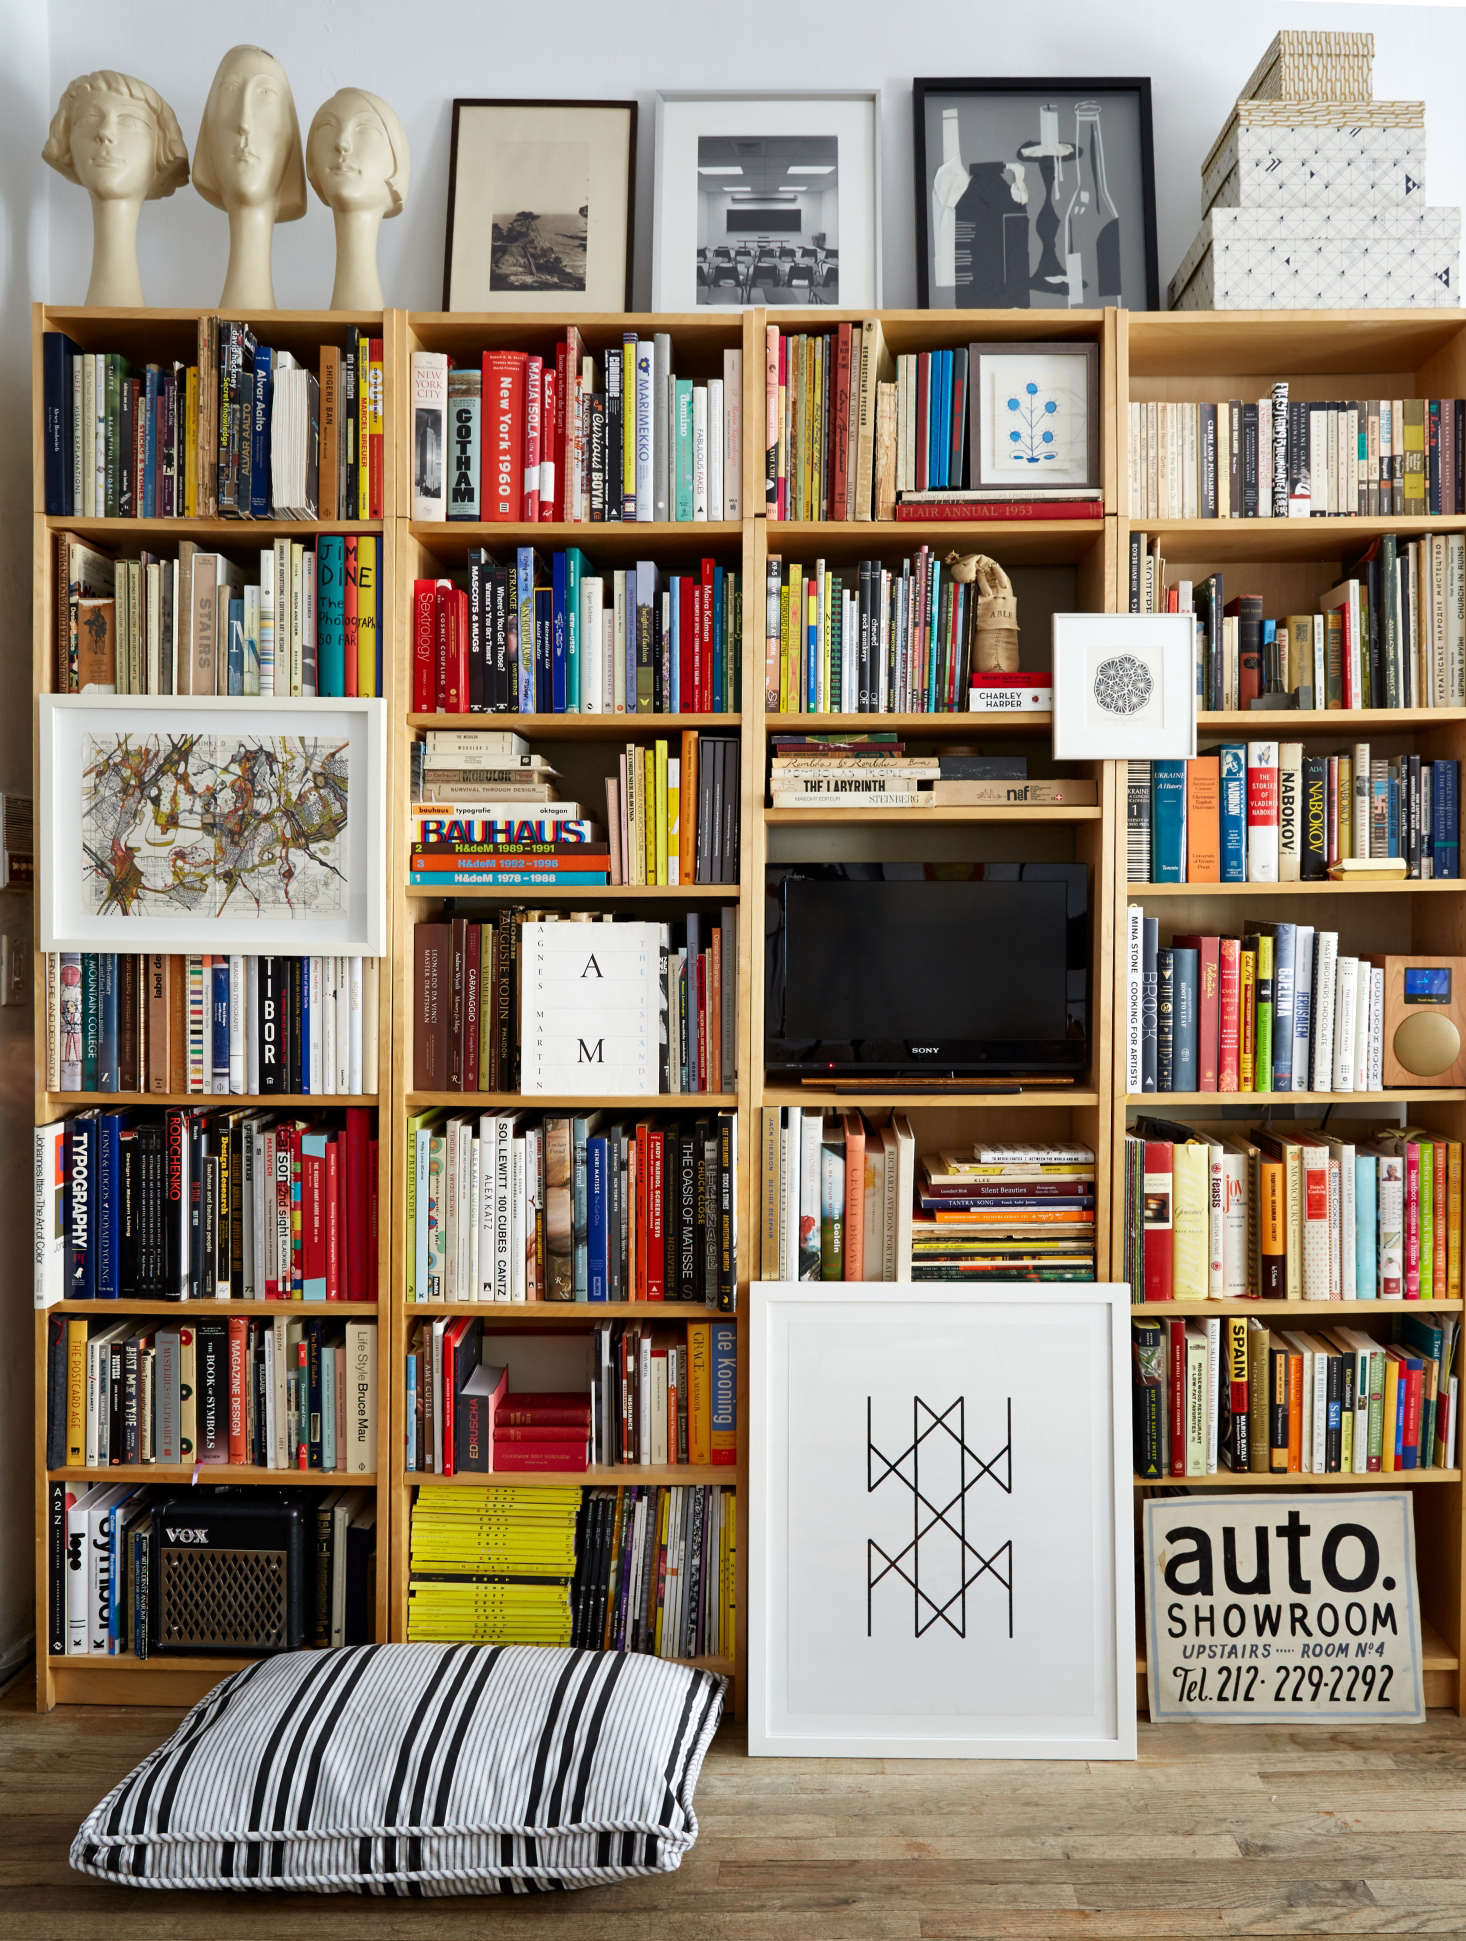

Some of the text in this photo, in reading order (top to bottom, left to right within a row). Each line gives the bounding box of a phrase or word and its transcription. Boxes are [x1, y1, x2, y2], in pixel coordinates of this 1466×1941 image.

[229, 355, 238, 388] hockney
[256, 370, 266, 400] Alvar
[415, 380, 441, 388] YORK
[416, 371, 441, 379] NEW
[416, 390, 441, 398] CITY
[610, 357, 620, 397] commune
[256, 402, 264, 431] Aalto
[528, 362, 538, 438] MAIJA ISOLA
[639, 379, 649, 461] MARIMEKKO
[221, 402, 229, 446] Knowledge
[499, 377, 511, 495] New York 1960
[453, 409, 474, 503] GOTHAM
[592, 414, 604, 508] Curious BOYM
[902, 506, 1032, 517] FLAIR ANNUAL 1953
[320, 542, 358, 560] JIM
[199, 598, 211, 668] STAIRS
[418, 593, 433, 661] Sextrology
[497, 586, 505, 671] Where'd You Get Those?
[703, 585, 711, 642] Maira Kalman
[871, 619, 879, 646] chewed
[804, 780, 824, 792] THE
[1310, 767, 1323, 775] ADA
[869, 795, 919, 803] STEINBERG
[1282, 772, 1295, 850] NABOKOV
[1309, 781, 1323, 853] NABOKOV
[418, 820, 586, 842] BAUHAUS
[455, 844, 494, 853] H&deM
[416, 874, 420, 882] 1
[455, 874, 493, 882] H&deM
[417, 859, 424, 867] 3
[458, 860, 496, 868] H&deM
[1131, 917, 1139, 940] MINA
[499, 916, 510, 1019] AUGUSTE RODIN
[581, 954, 603, 978] A
[1131, 944, 1139, 973] STONE
[88, 961, 96, 1057] MOUNTAIN COLLEGE
[264, 957, 276, 1064] TIBOR
[468, 969, 476, 1021] CARAVAGGIO
[1142, 972, 1157, 1041] BROCK
[1277, 968, 1293, 1017] GJELINA
[1296, 991, 1311, 1038] JERUSALEM
[577, 1039, 605, 1063] M
[1130, 1048, 1138, 1085] ARTISTS
[35, 1135, 45, 1177] Johannes
[170, 1117, 181, 1200] RODCHENKO
[220, 1137, 228, 1214] Design Research
[35, 1179, 45, 1196] Itten
[36, 1200, 45, 1216] The
[72, 1133, 87, 1247] TYPOGRAPHY
[484, 1175, 493, 1230] ALEX KATZ
[498, 1124, 507, 1295] SOL LEWITT 100 CUBES CANTZ
[683, 1143, 693, 1278] THE OASIS OF MATISSE
[1211, 1178, 1222, 1208] Feasts
[1291, 1165, 1299, 1226] MOMOFUKU
[36, 1219, 45, 1231] Art
[277, 1188, 289, 1237] 2nd sight
[36, 1240, 45, 1264] Color
[206, 1355, 214, 1386] BOOK
[1233, 1325, 1245, 1378] SPAIN
[72, 1340, 80, 1429] THE POSTCARD AGE
[125, 1346, 137, 1426] JUST MY TYPE
[232, 1340, 241, 1436] MAGAZINE DESIGN
[357, 1332, 368, 1442] Life Style Bruce Mau
[714, 1331, 736, 1423] de Kooning
[206, 1397, 215, 1448] SYMBOLS
[165, 1528, 208, 1543] VOX
[1164, 1511, 1396, 1596] auto.
[1168, 1602, 1398, 1638] SHOWROOM
[1183, 1644, 1271, 1659] UPSTAIRS
[1301, 1643, 1349, 1659] ROOM
